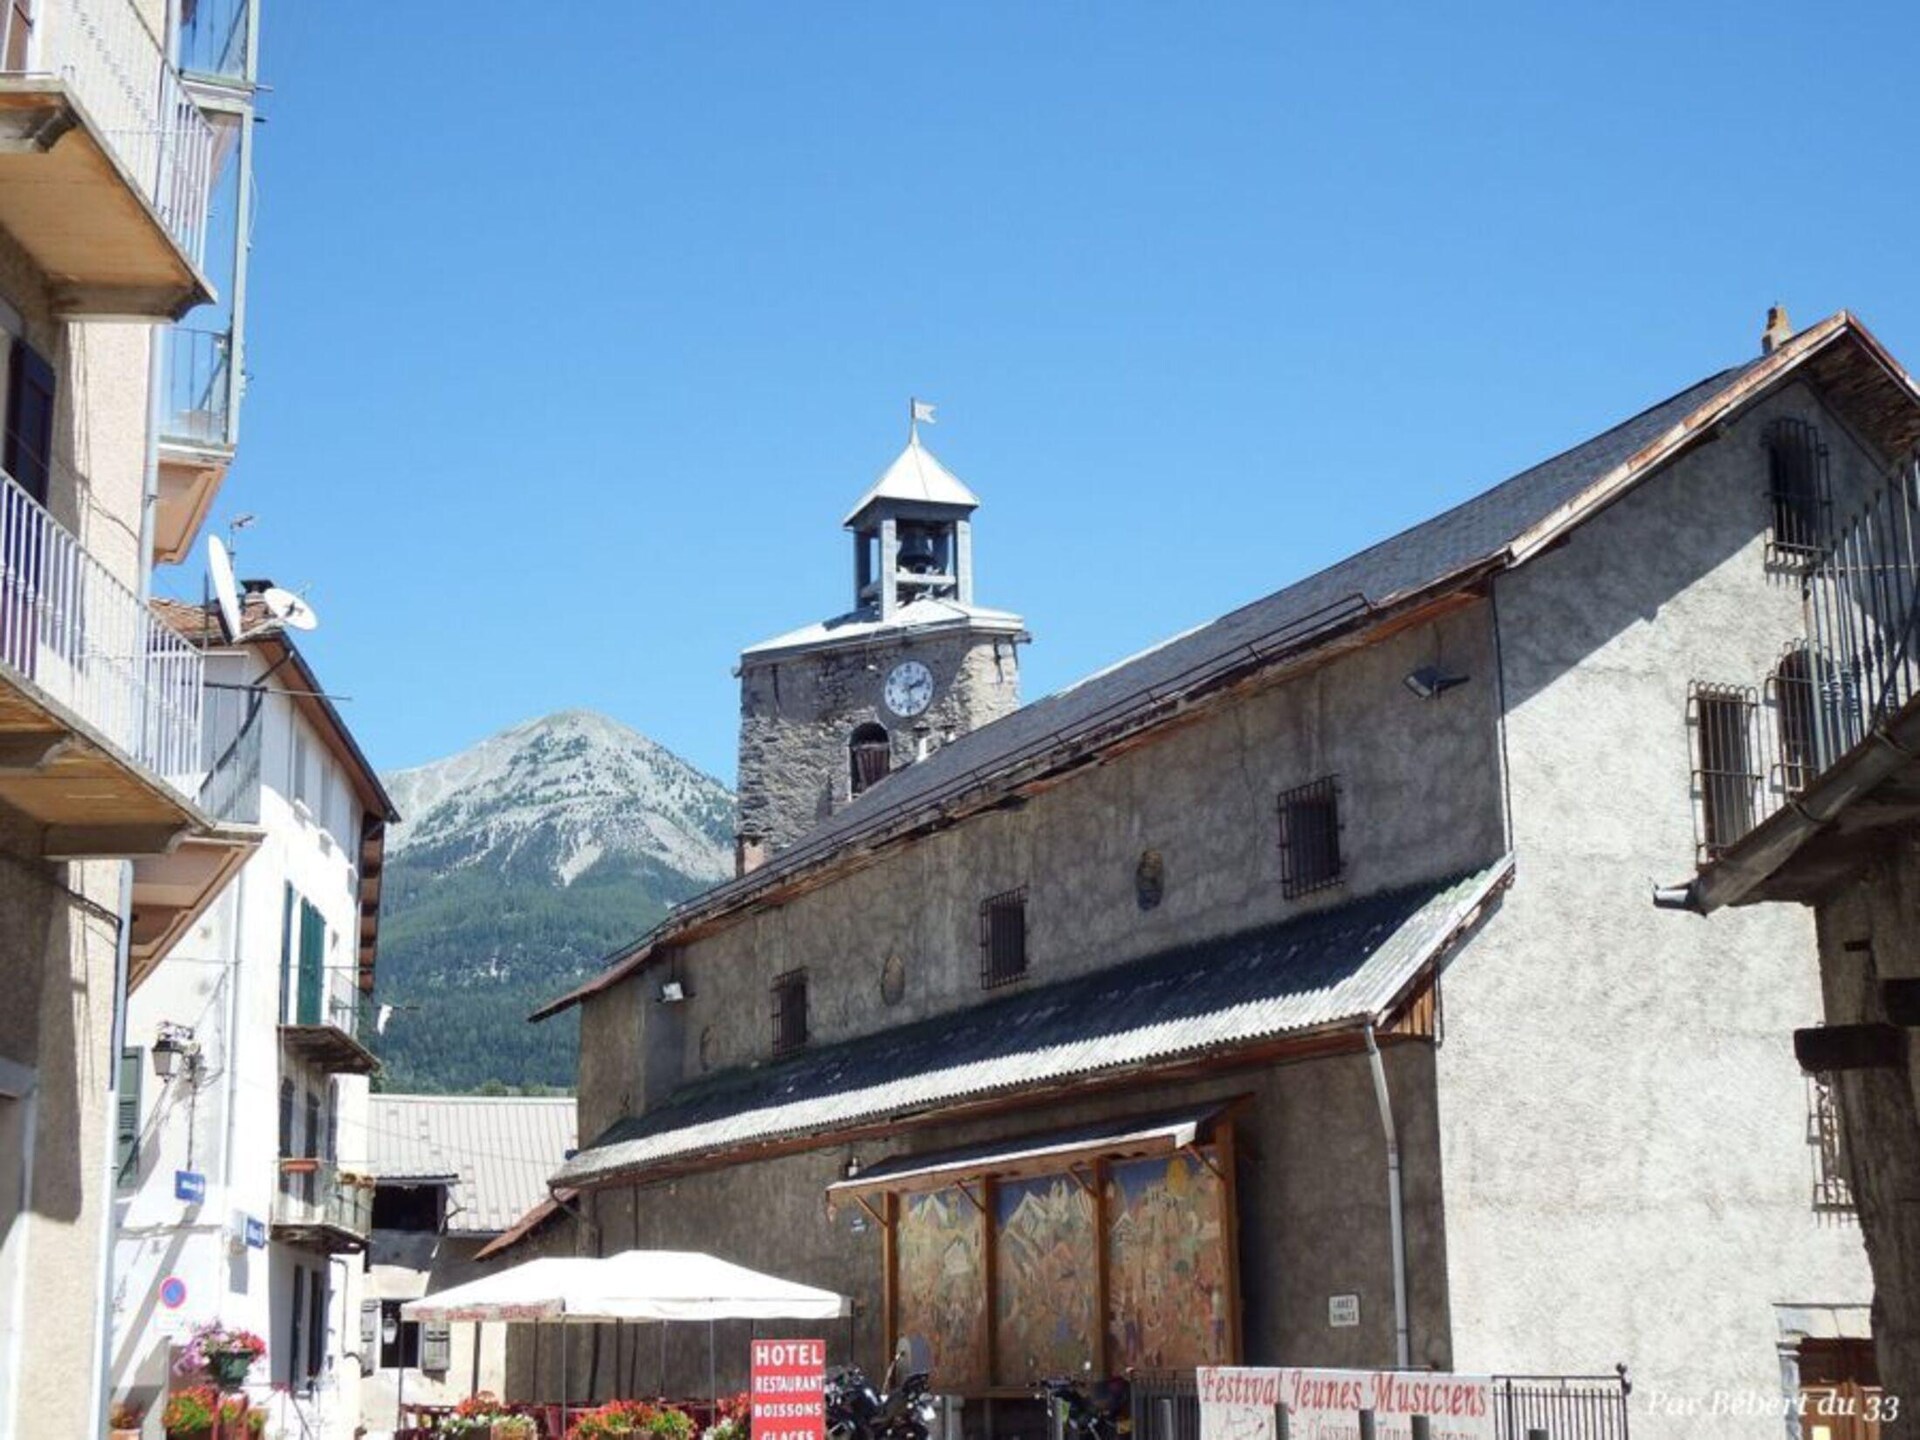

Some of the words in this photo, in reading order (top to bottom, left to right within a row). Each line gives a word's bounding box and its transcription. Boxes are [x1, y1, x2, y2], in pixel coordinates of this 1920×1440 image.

[756, 1345, 823, 1366] HOTEL
[755, 1375, 823, 1393] RESTAURANT
[1202, 1368, 1282, 1406] Festival
[1289, 1371, 1362, 1415] Jeunes
[1371, 1374, 1487, 1417] Musiciens
[755, 1402, 821, 1418] BOISSONS
